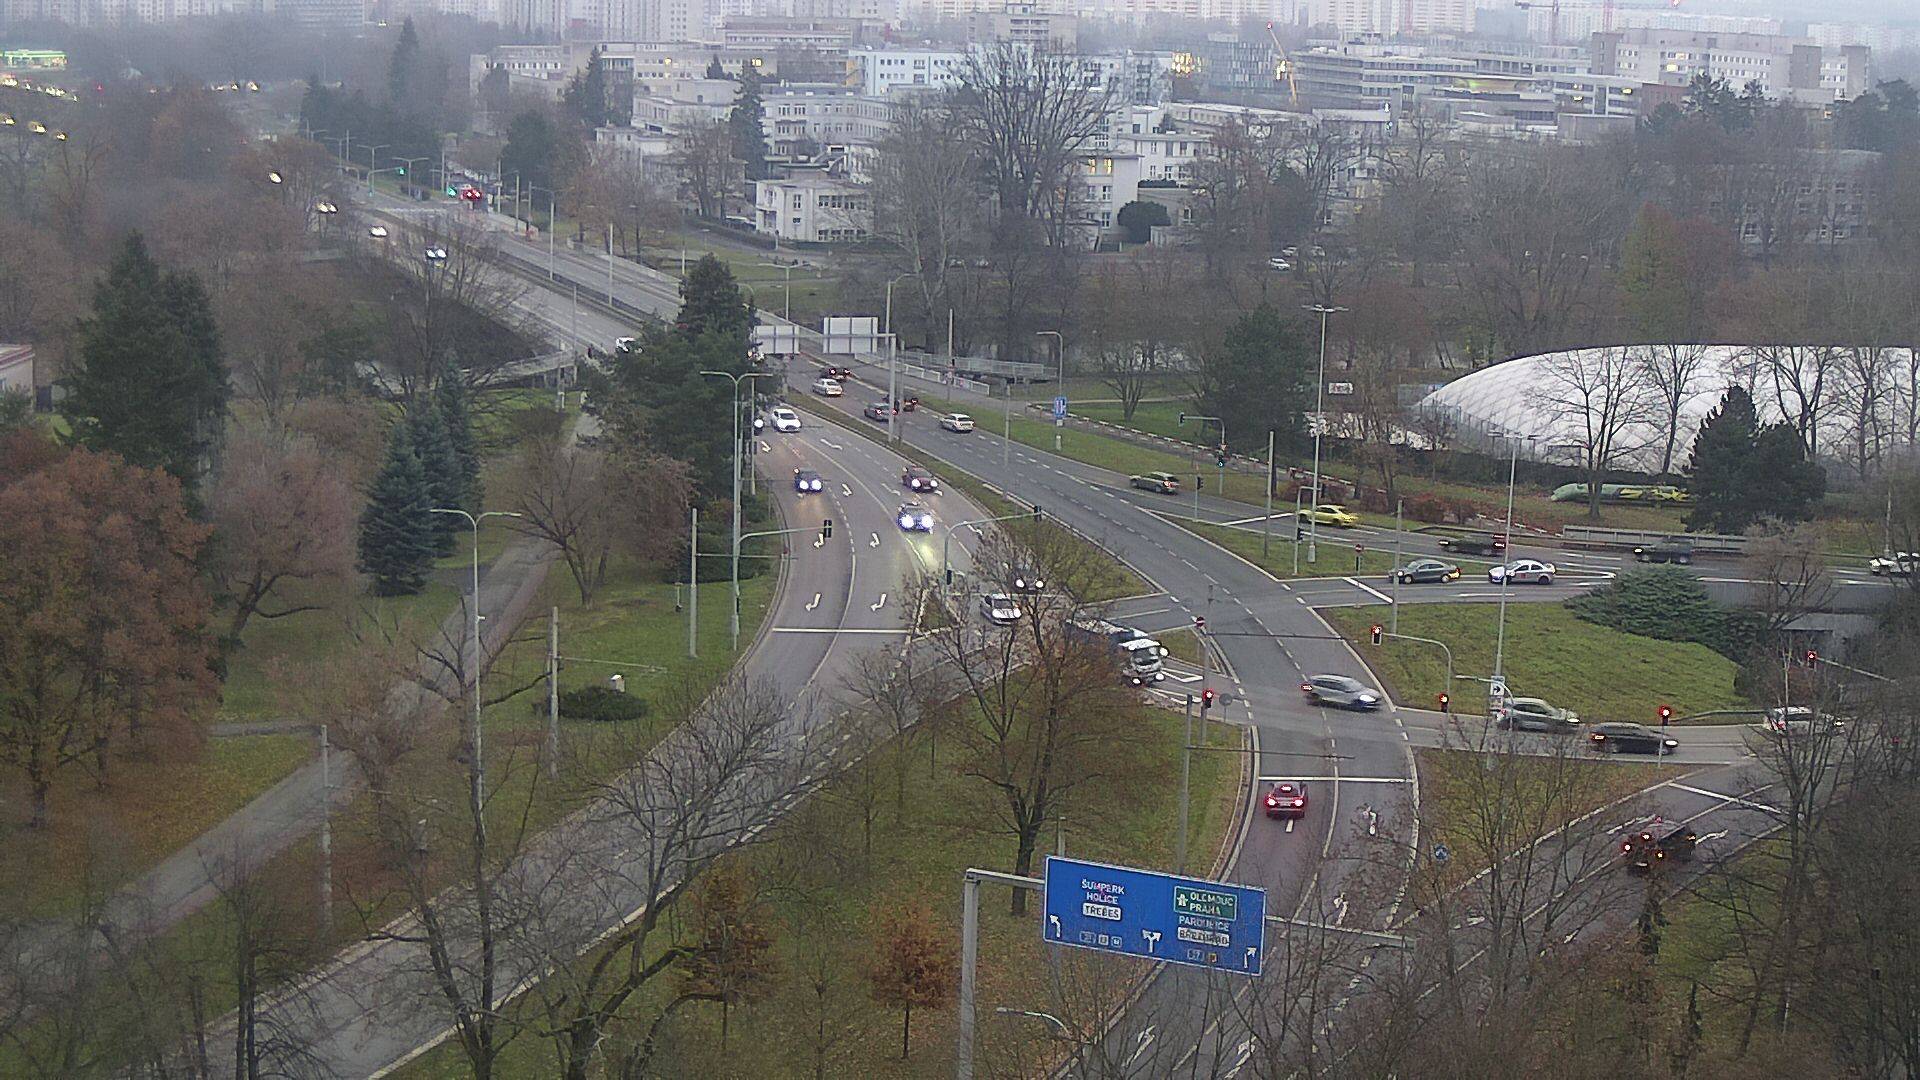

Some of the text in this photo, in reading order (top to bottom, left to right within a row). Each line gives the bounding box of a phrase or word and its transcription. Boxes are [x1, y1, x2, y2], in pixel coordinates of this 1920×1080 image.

[1086, 891, 1119, 905] HOLICE
[1189, 891, 1234, 907] OLOMOUC
[1189, 902, 1221, 916] PRAHA
